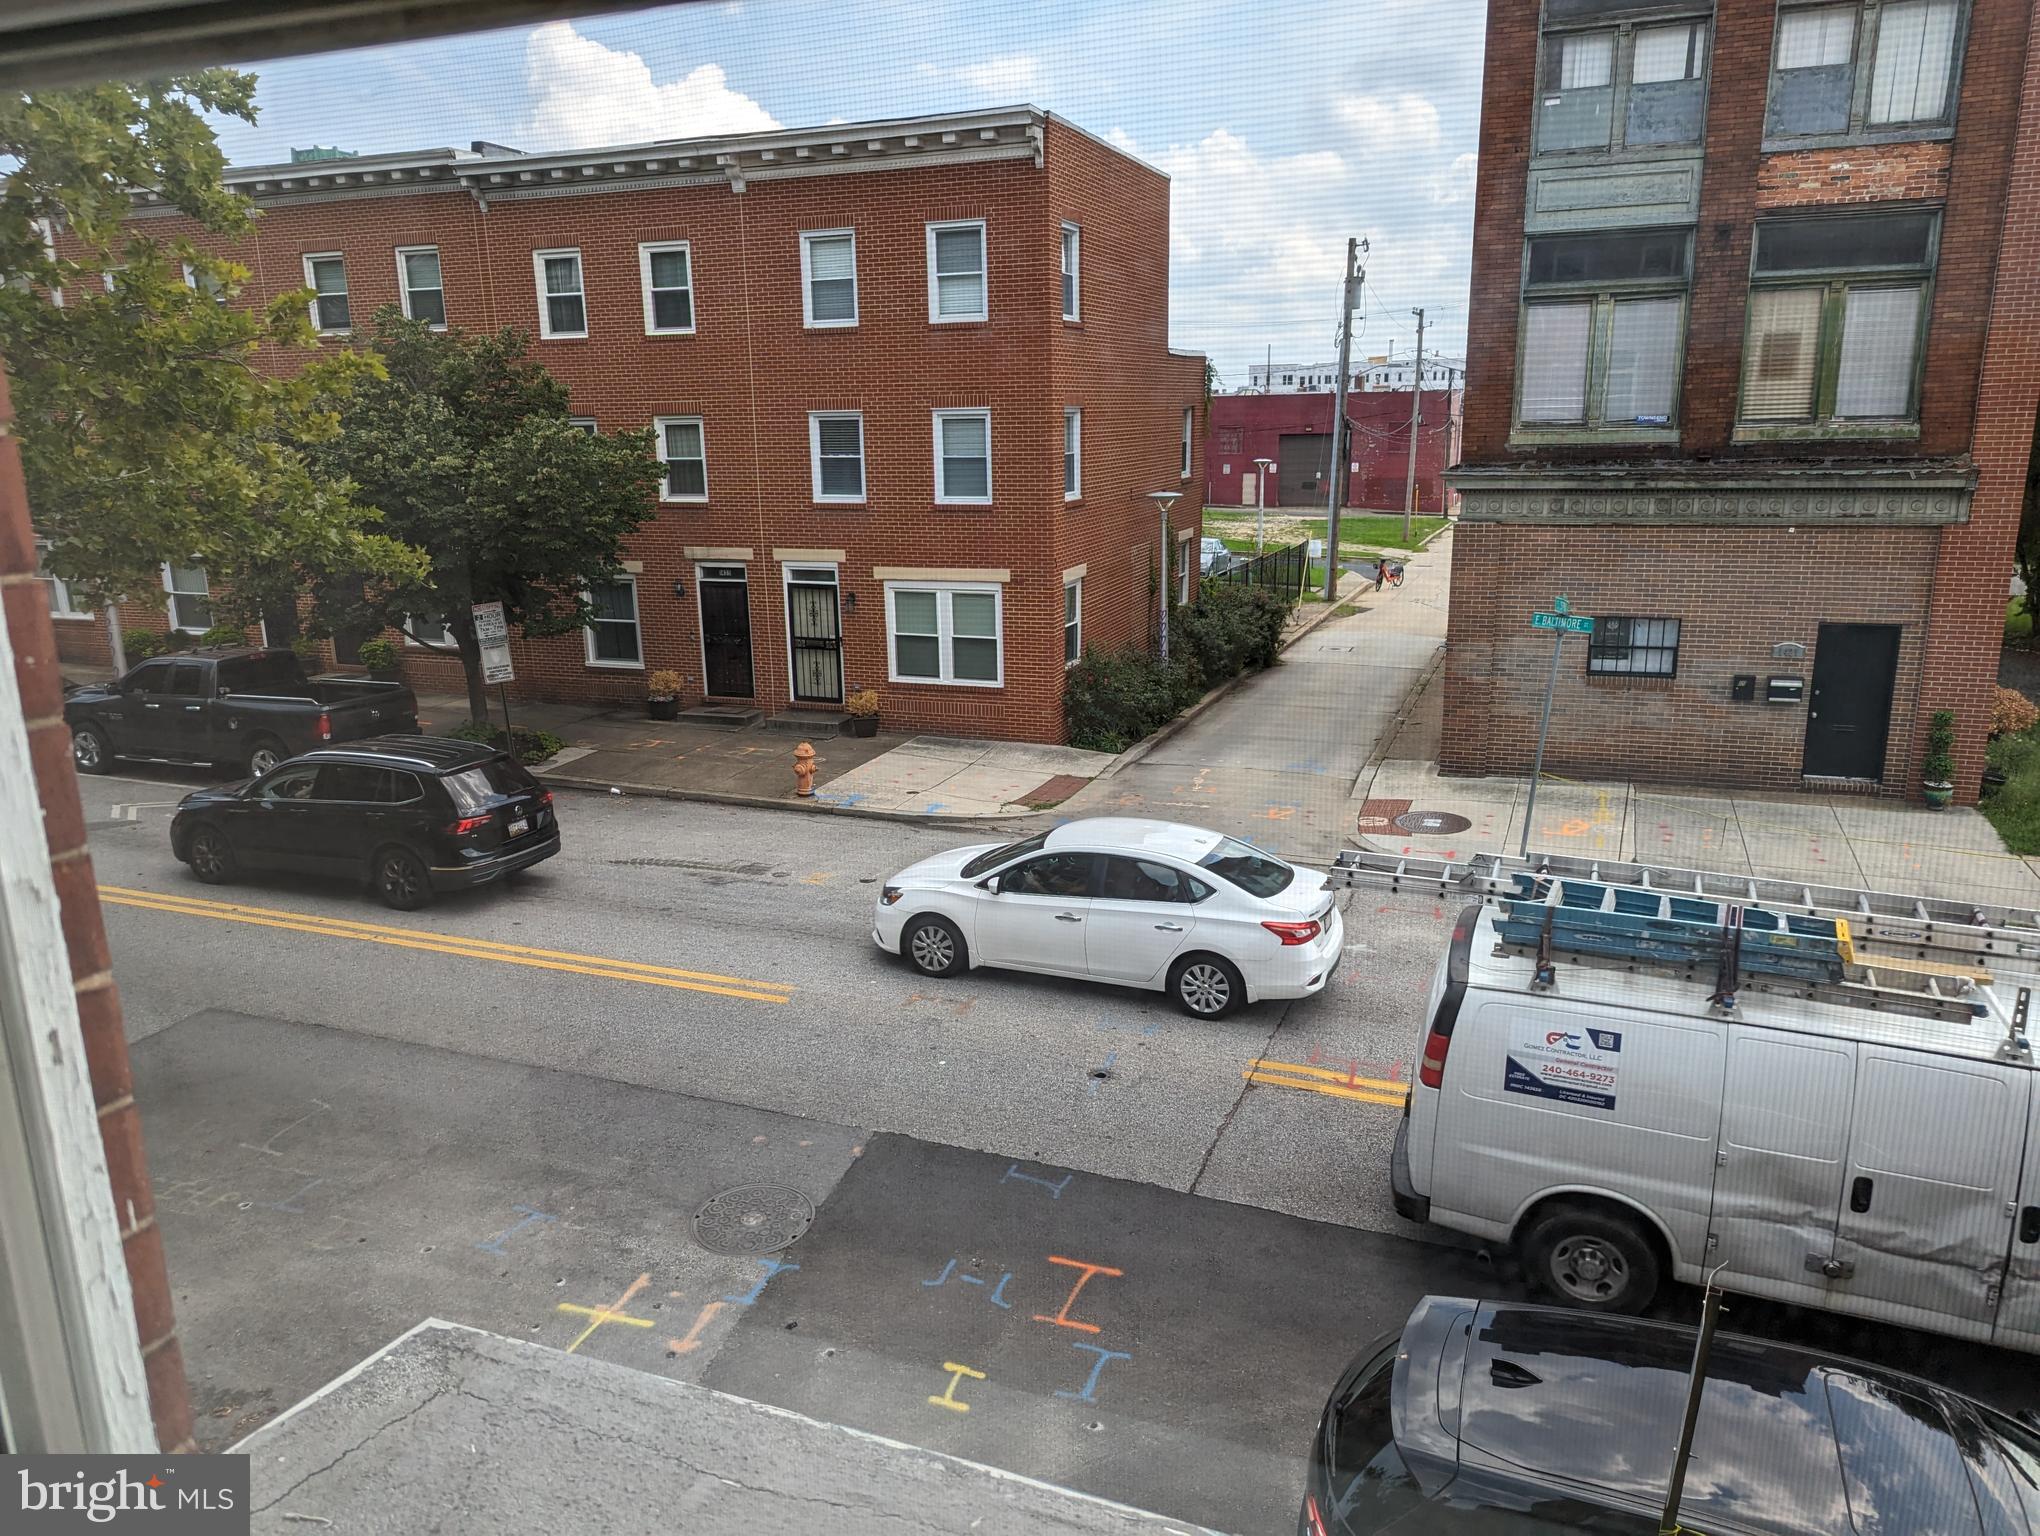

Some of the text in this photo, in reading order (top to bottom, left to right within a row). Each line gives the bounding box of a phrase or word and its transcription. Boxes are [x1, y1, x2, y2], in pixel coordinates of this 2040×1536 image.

[1535, 615, 1540, 625] E
[1542, 615, 1582, 629] BALTIMORE
[1588, 1053, 1603, 1061] LLC
[1580, 1061, 1614, 1072] Contractor
[1542, 1064, 1615, 1084] 240-464-9273
